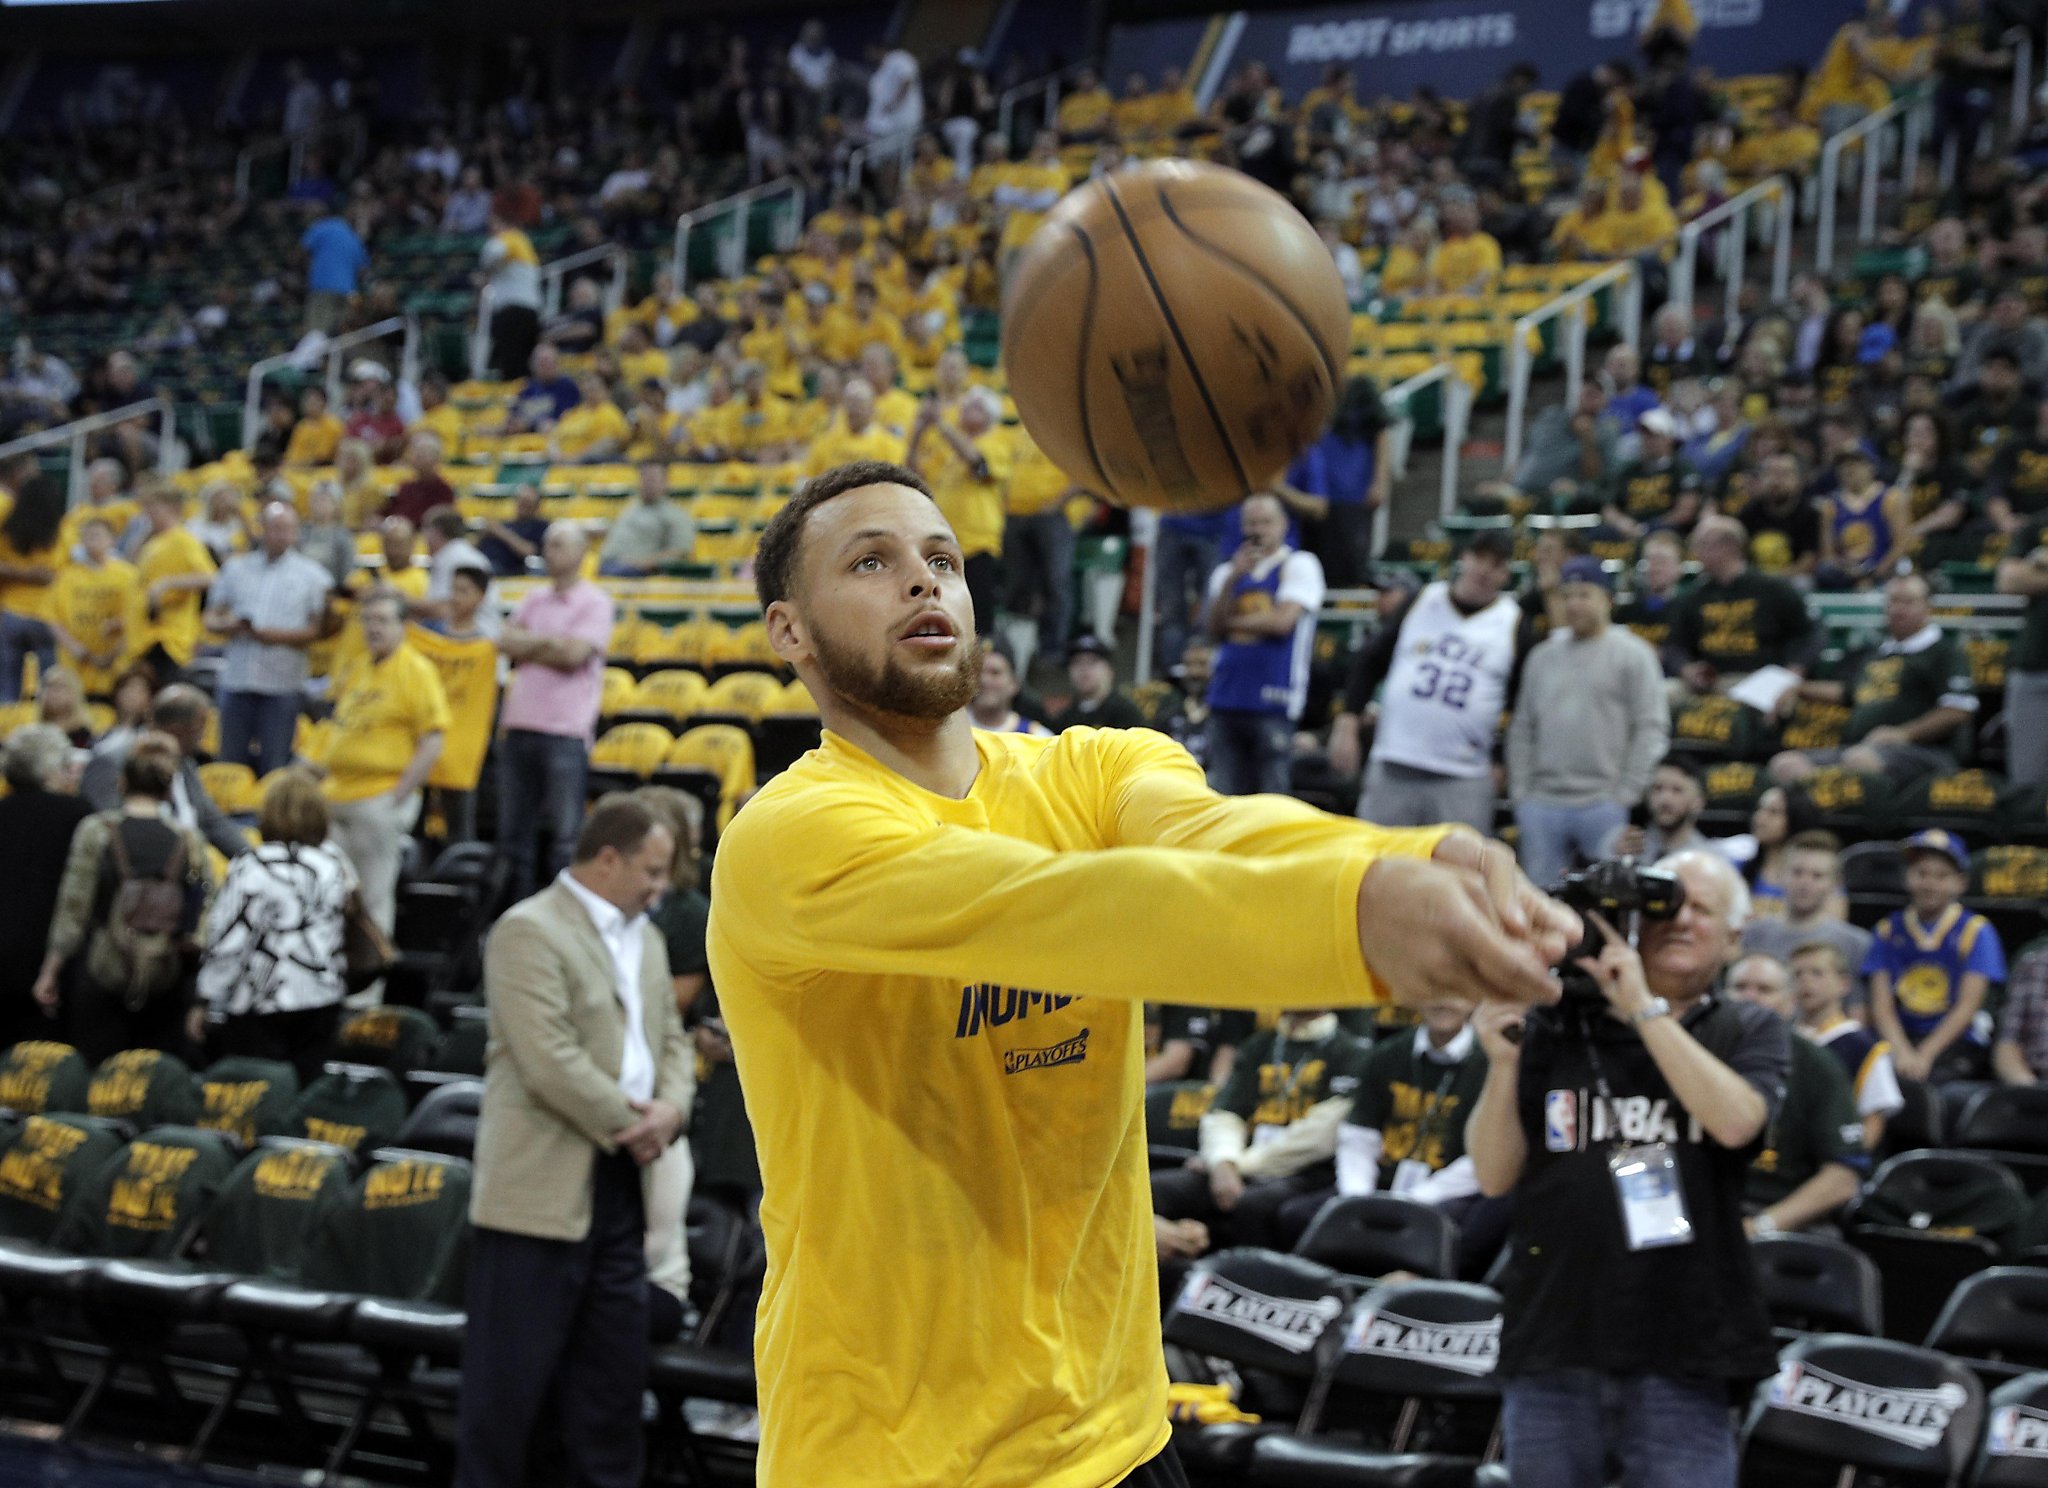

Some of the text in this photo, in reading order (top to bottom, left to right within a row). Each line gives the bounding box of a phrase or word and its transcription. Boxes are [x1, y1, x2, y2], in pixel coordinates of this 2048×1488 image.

[1286, 13, 1515, 64] ROOT SPORTS
[1411, 661, 1475, 709] 32
[1015, 1040, 1087, 1071] PLAYOFFS
[1203, 1284, 1326, 1338] PLAYOFFS
[1795, 1371, 1951, 1430] PLAYOFFS
